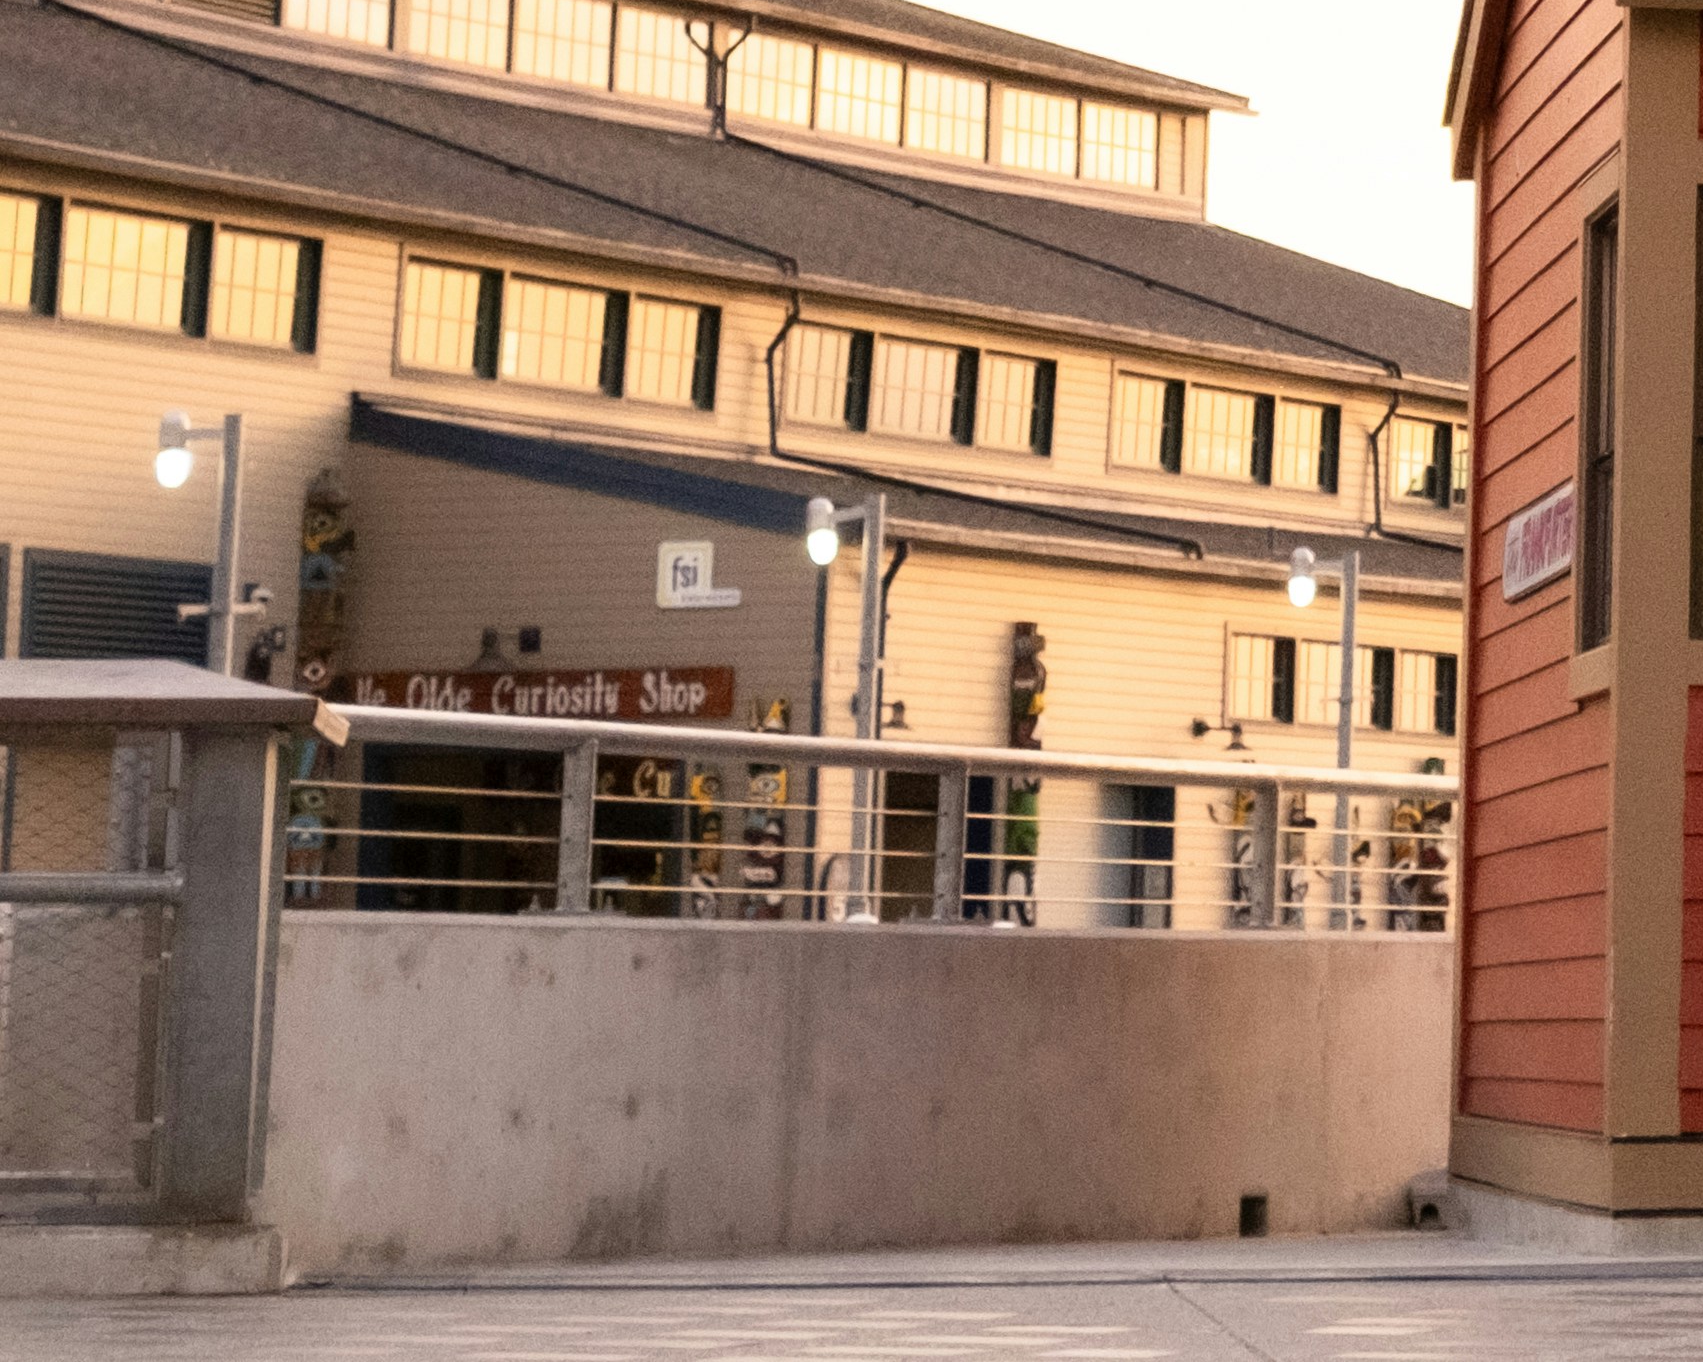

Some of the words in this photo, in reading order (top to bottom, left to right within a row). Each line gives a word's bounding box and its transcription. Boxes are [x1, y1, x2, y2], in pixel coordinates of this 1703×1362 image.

[672, 556, 698, 592] fsi
[406, 674, 473, 712] Olde
[491, 672, 620, 715] Curiosity
[639, 671, 707, 714] Shop
